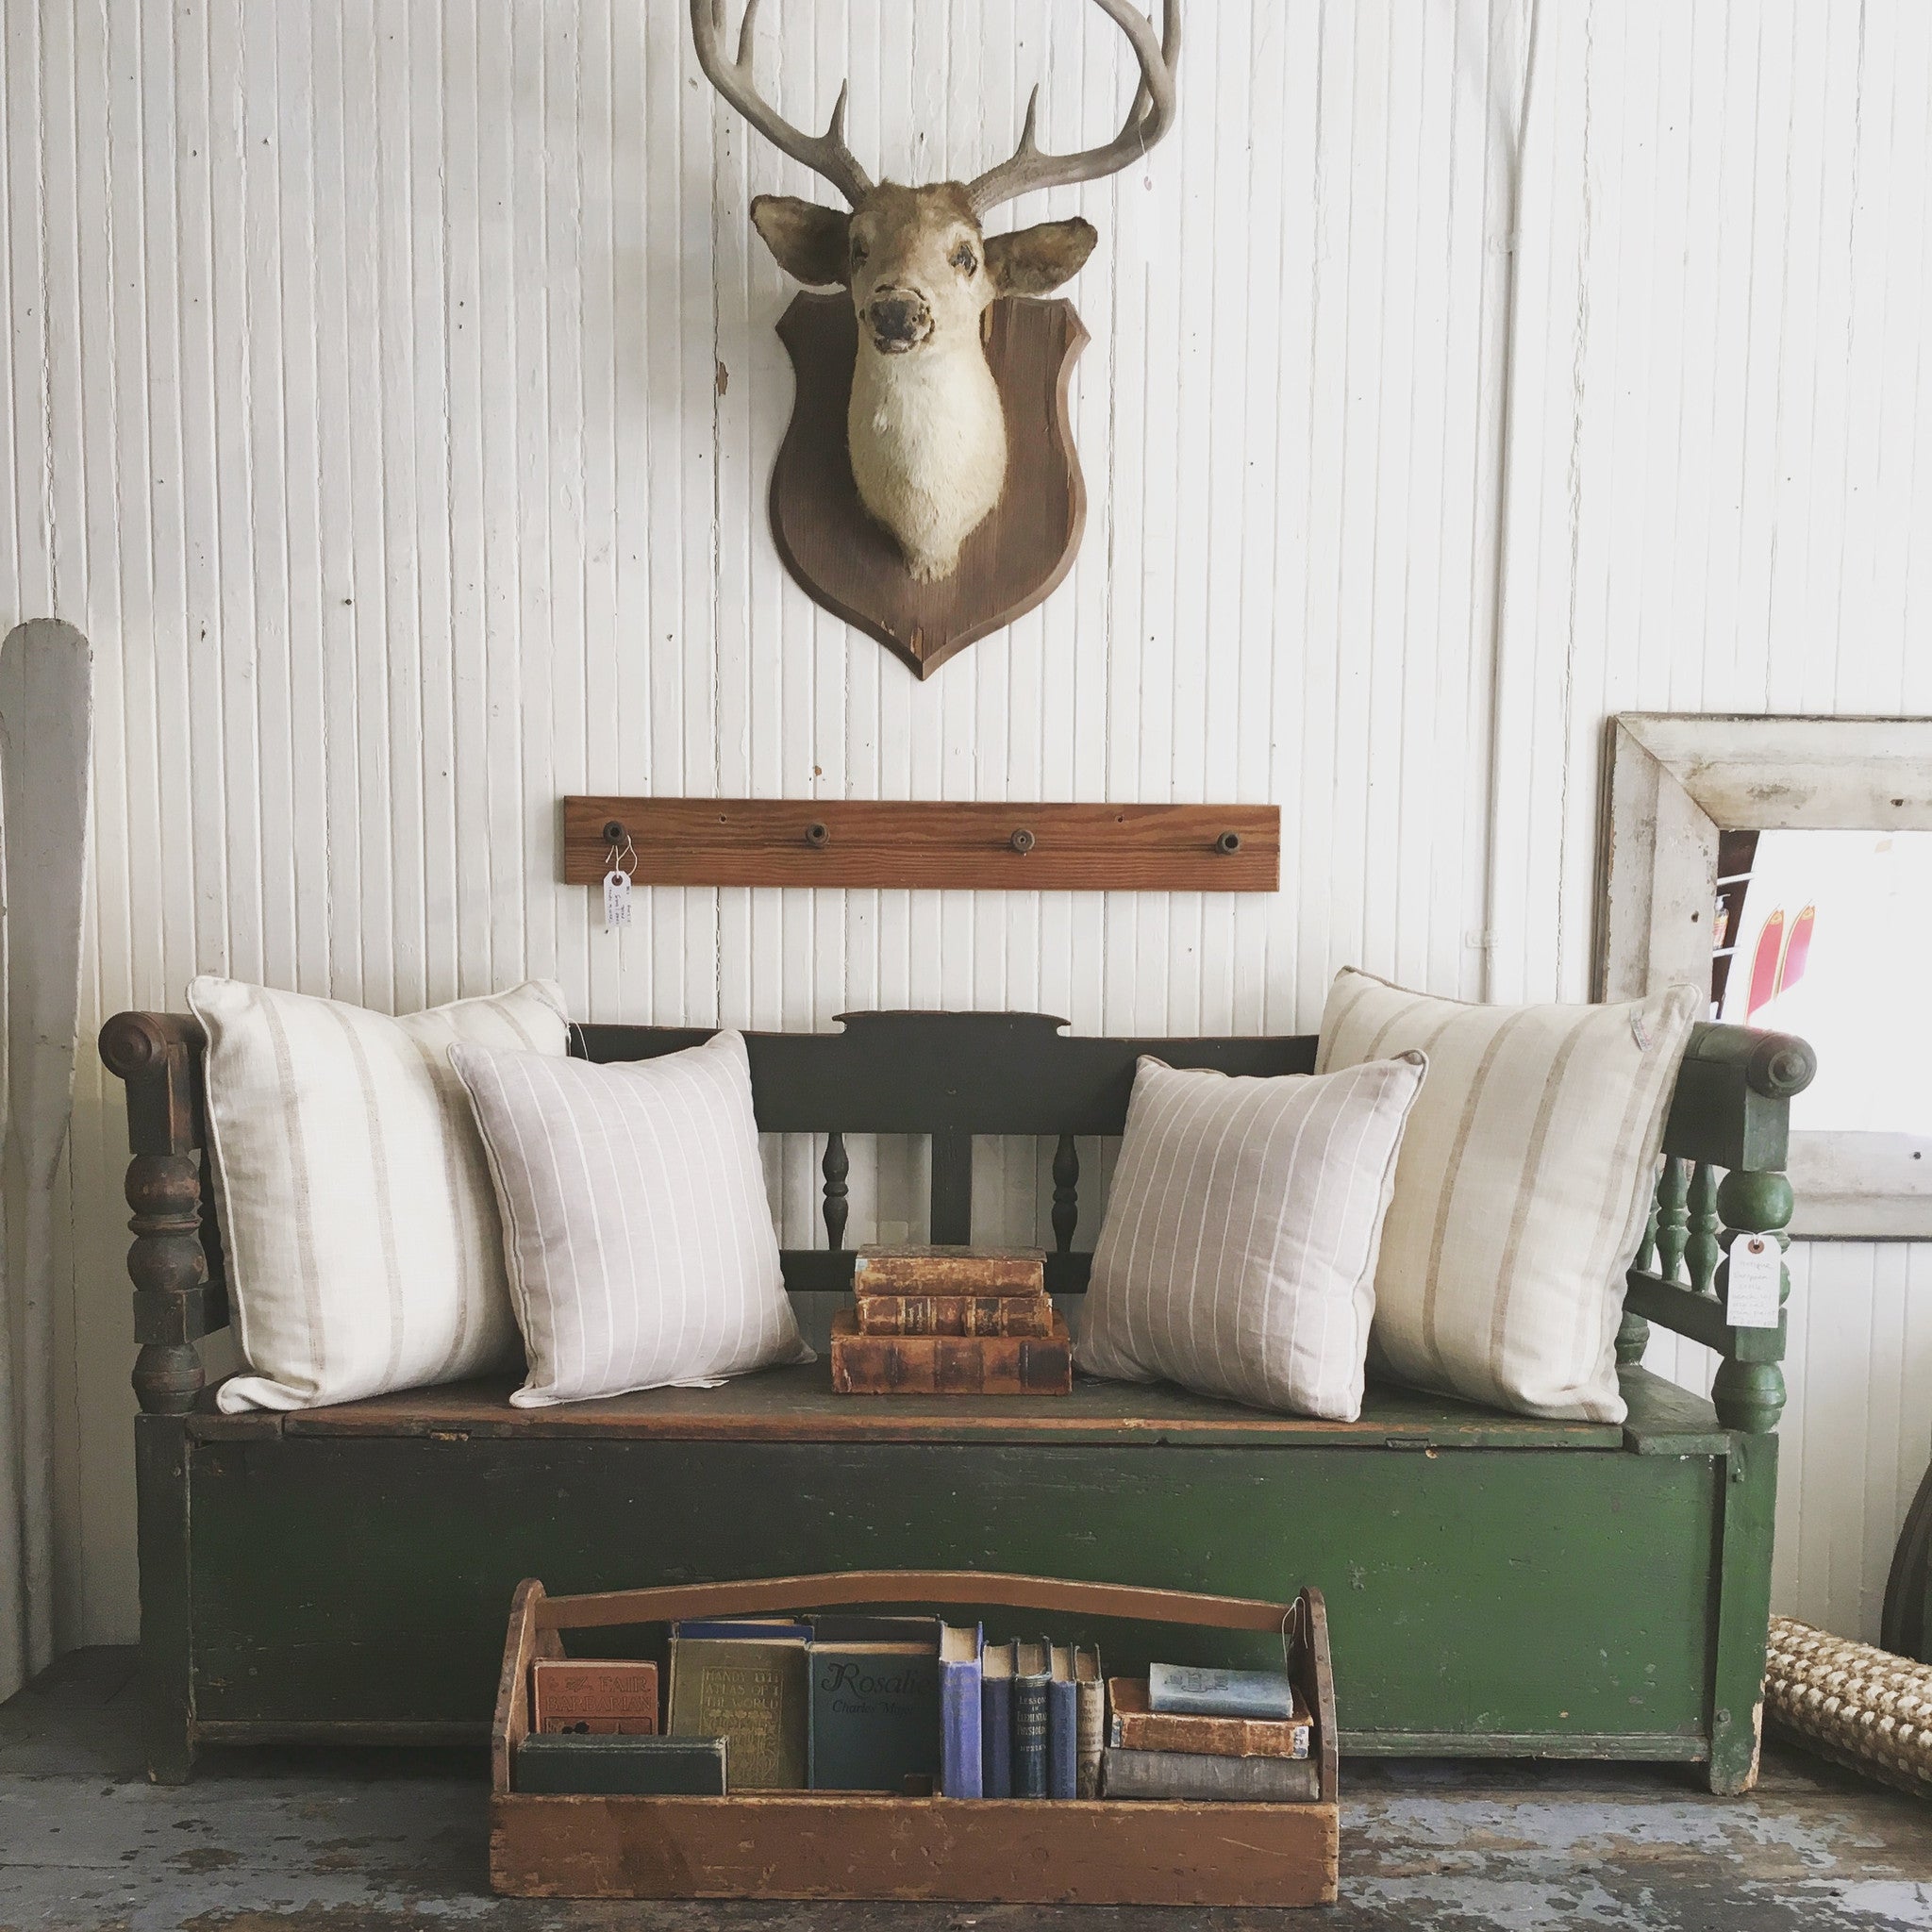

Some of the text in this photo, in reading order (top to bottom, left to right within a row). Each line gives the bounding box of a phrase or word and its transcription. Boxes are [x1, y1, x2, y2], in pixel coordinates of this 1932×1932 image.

[599, 1675, 651, 1692] FAIR
[706, 1671, 746, 1682] HANDY
[706, 1683, 769, 1696] ATLAS OF
[545, 1695, 652, 1712] BARBARIAN
[732, 1697, 778, 1709] WORLD
[832, 1699, 874, 1714] Charles
